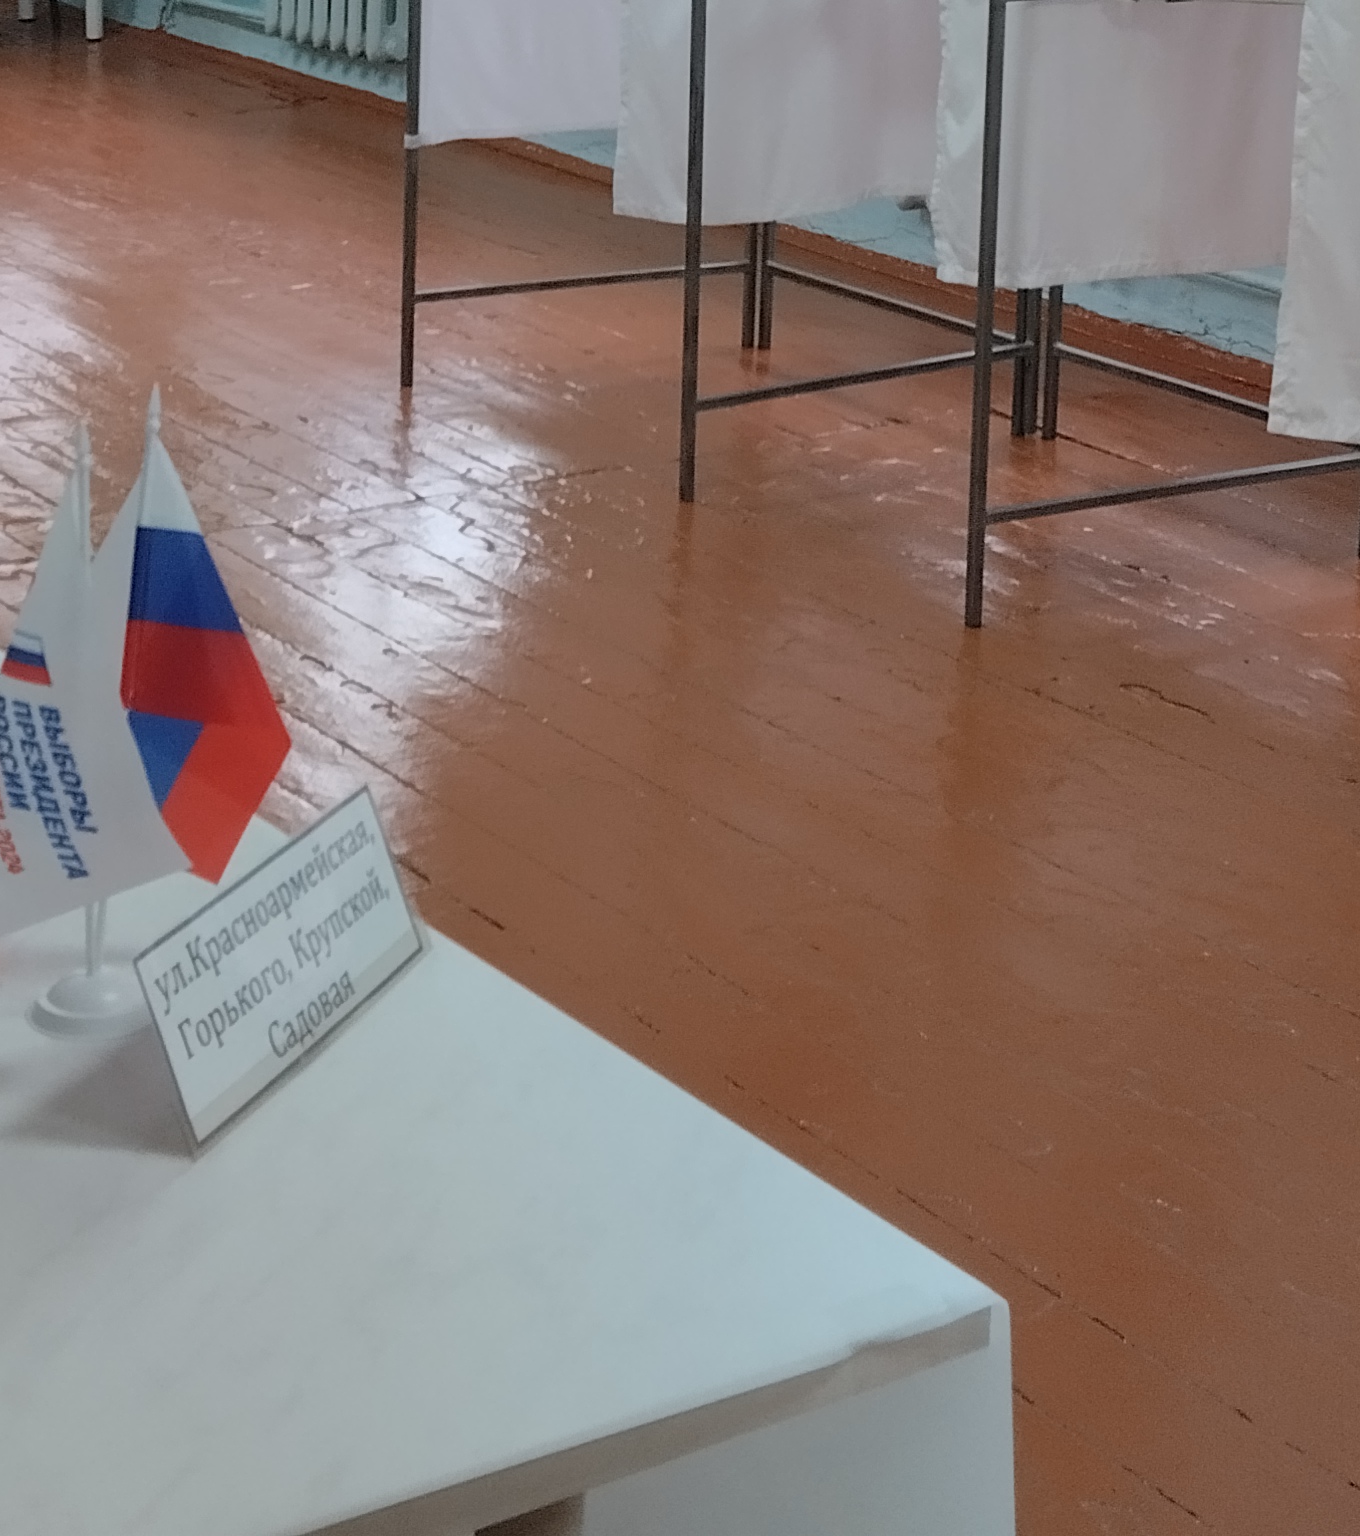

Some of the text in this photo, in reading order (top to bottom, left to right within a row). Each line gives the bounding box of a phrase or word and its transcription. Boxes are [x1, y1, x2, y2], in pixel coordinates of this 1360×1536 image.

[11, 698, 89, 880] ПРЕЗИДЕНТА
[38, 704, 98, 834] ВЫБОРЫ
[153, 820, 376, 1016] ул.Красноармейская,
[177, 866, 391, 1060] Горького, Крупской,
[267, 970, 357, 1059] Садовая
